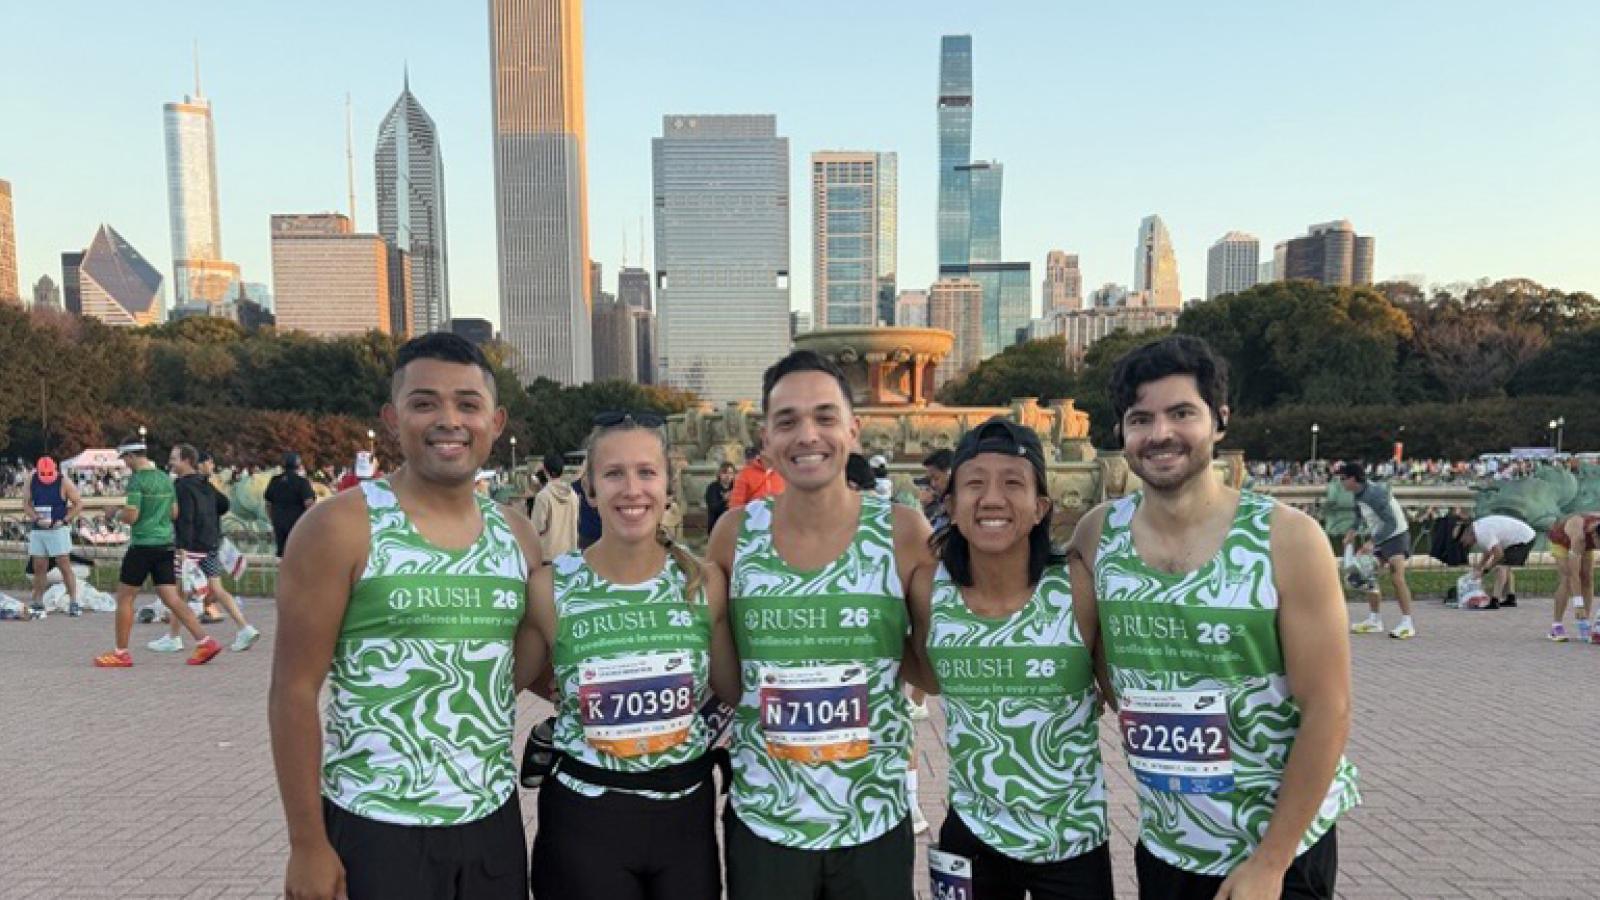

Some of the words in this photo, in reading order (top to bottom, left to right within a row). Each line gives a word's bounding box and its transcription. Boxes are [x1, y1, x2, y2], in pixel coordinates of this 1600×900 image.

[416, 587, 481, 608] RUSH
[593, 610, 657, 634] RUSH
[762, 608, 827, 630] RUSH
[1124, 615, 1189, 639] RUSH
[954, 659, 1015, 678] RUSH
[588, 697, 604, 720] K
[610, 687, 691, 718] 70398
[767, 704, 782, 725] N
[787, 698, 861, 725] 71041
